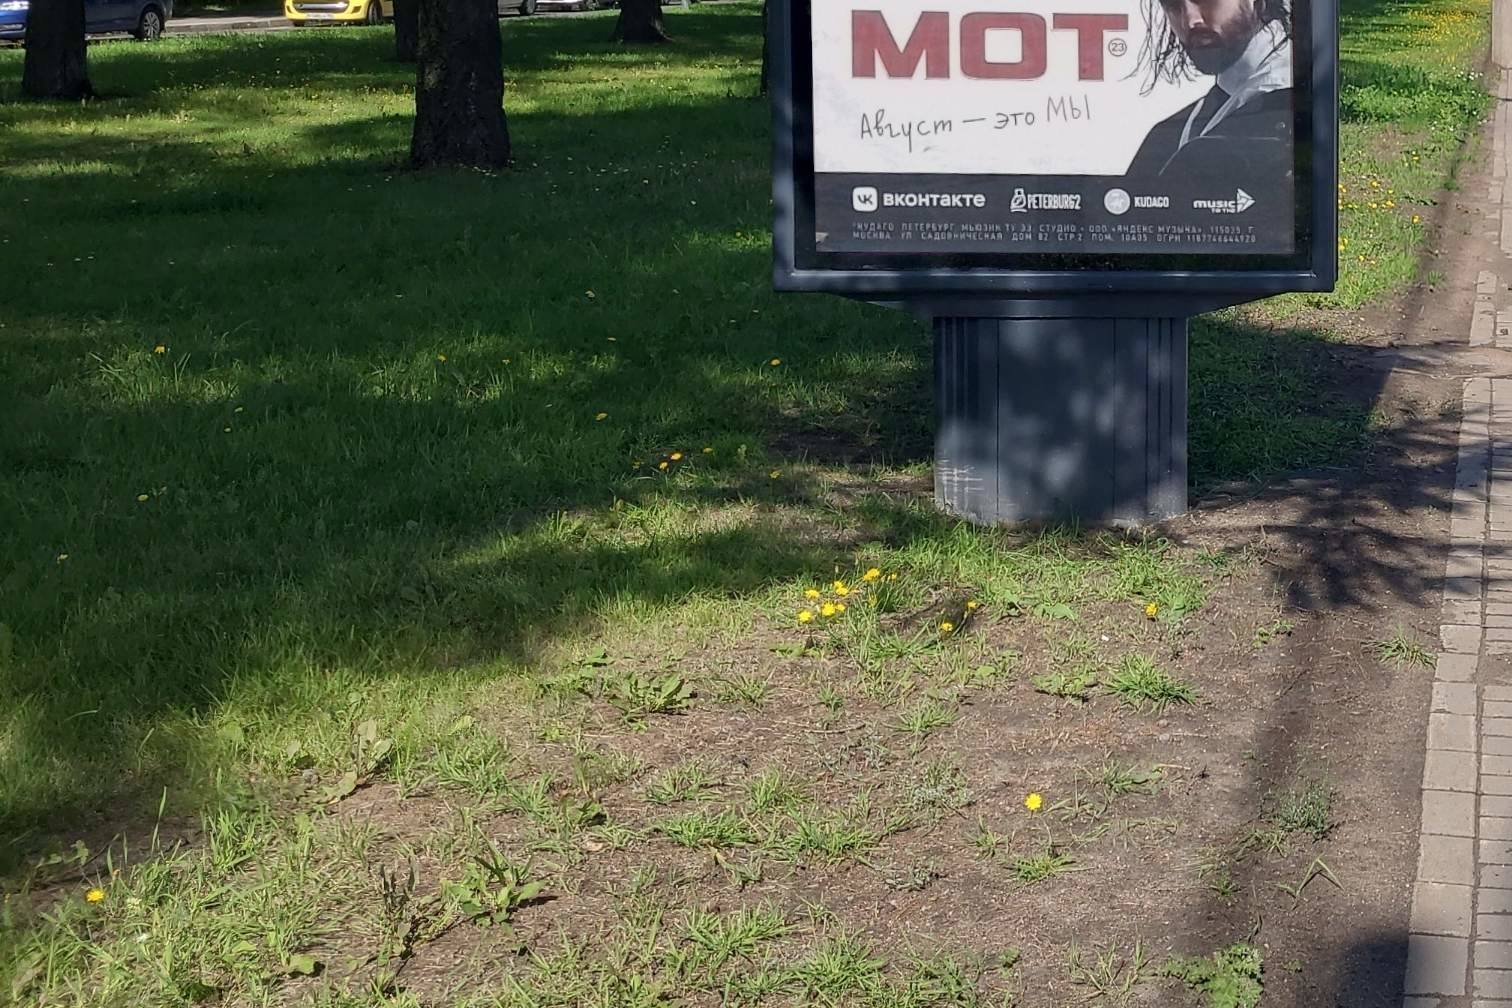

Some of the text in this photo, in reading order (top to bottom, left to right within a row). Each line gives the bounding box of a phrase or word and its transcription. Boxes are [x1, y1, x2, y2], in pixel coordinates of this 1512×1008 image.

[851, 9, 1129, 82] МОТ
[859, 108, 953, 153] Август
[993, 110, 1036, 130] это
[1133, 196, 1170, 208] KUDAGO
